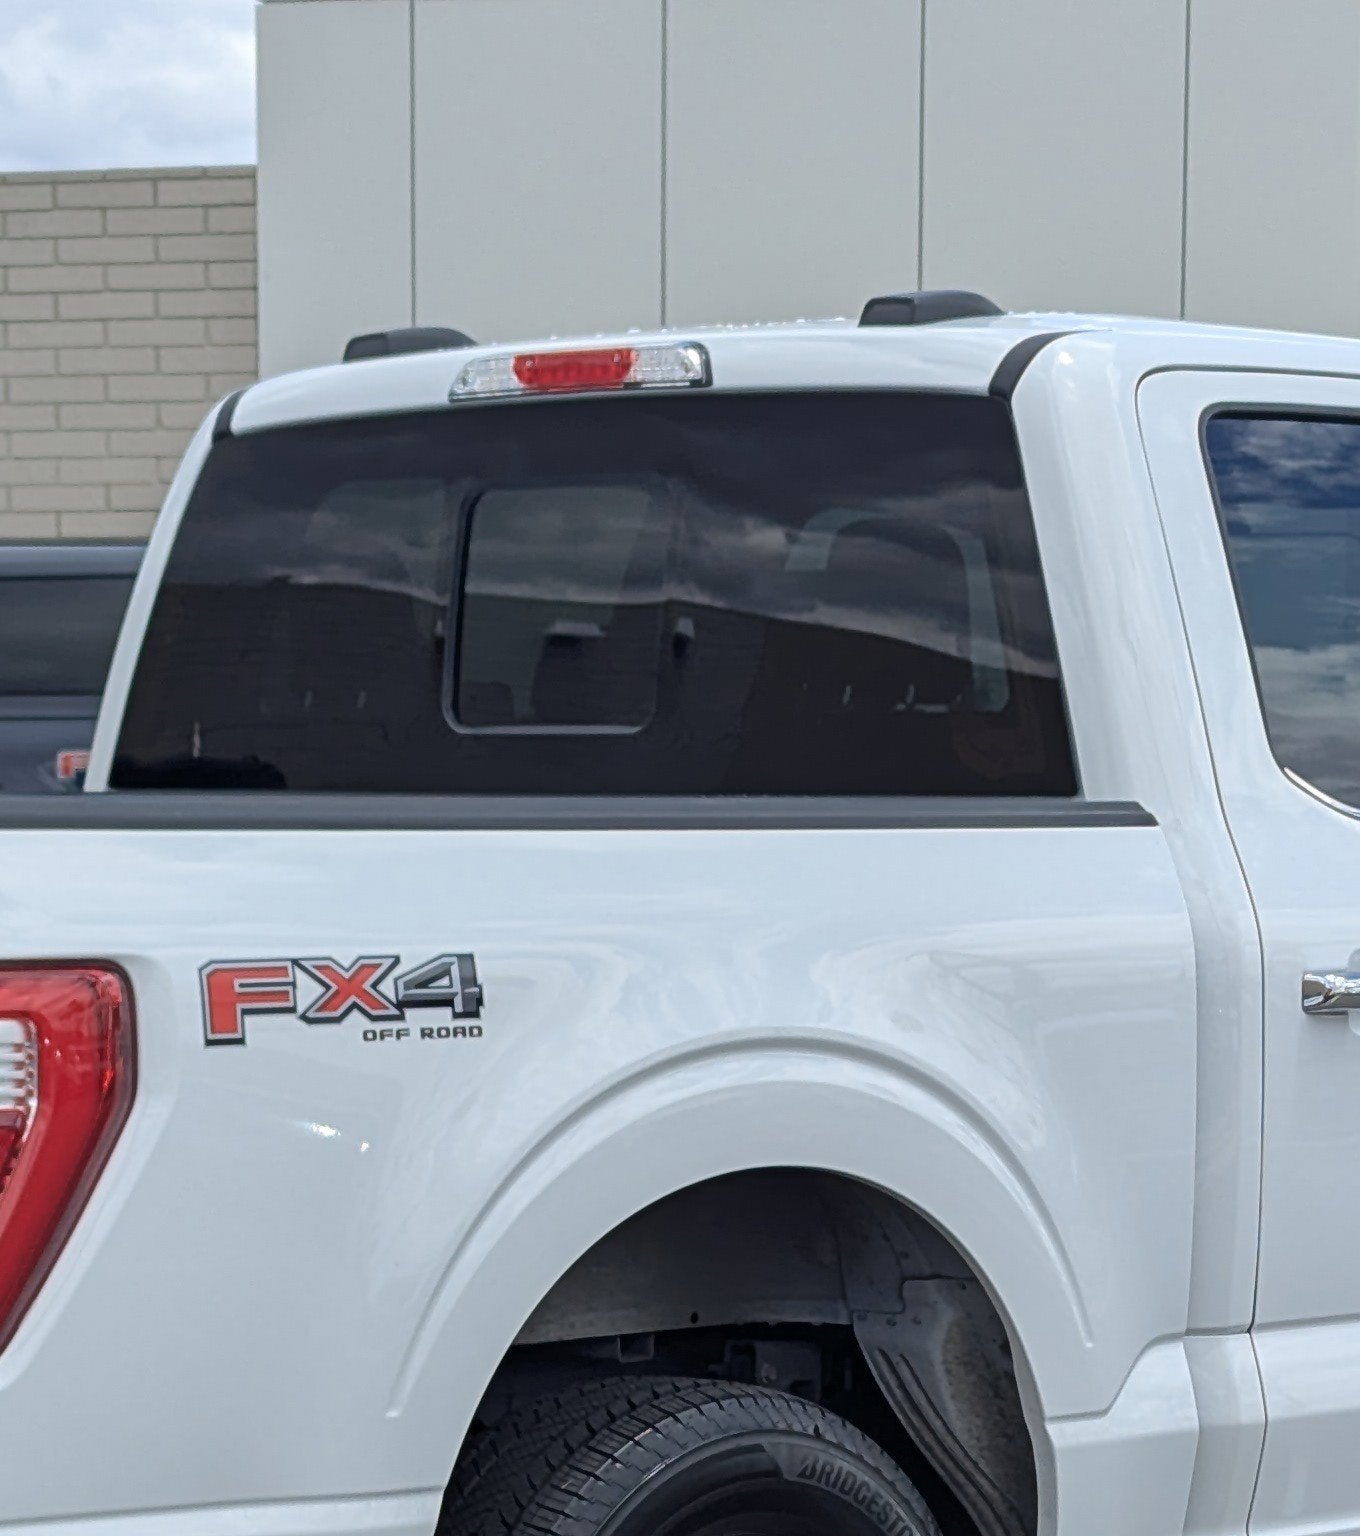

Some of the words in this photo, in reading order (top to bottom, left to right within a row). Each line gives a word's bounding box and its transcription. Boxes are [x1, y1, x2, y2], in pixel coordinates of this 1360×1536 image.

[198, 952, 484, 1047] FX4
[362, 1028, 411, 1042] OFF
[419, 1025, 484, 1040] ROAD
